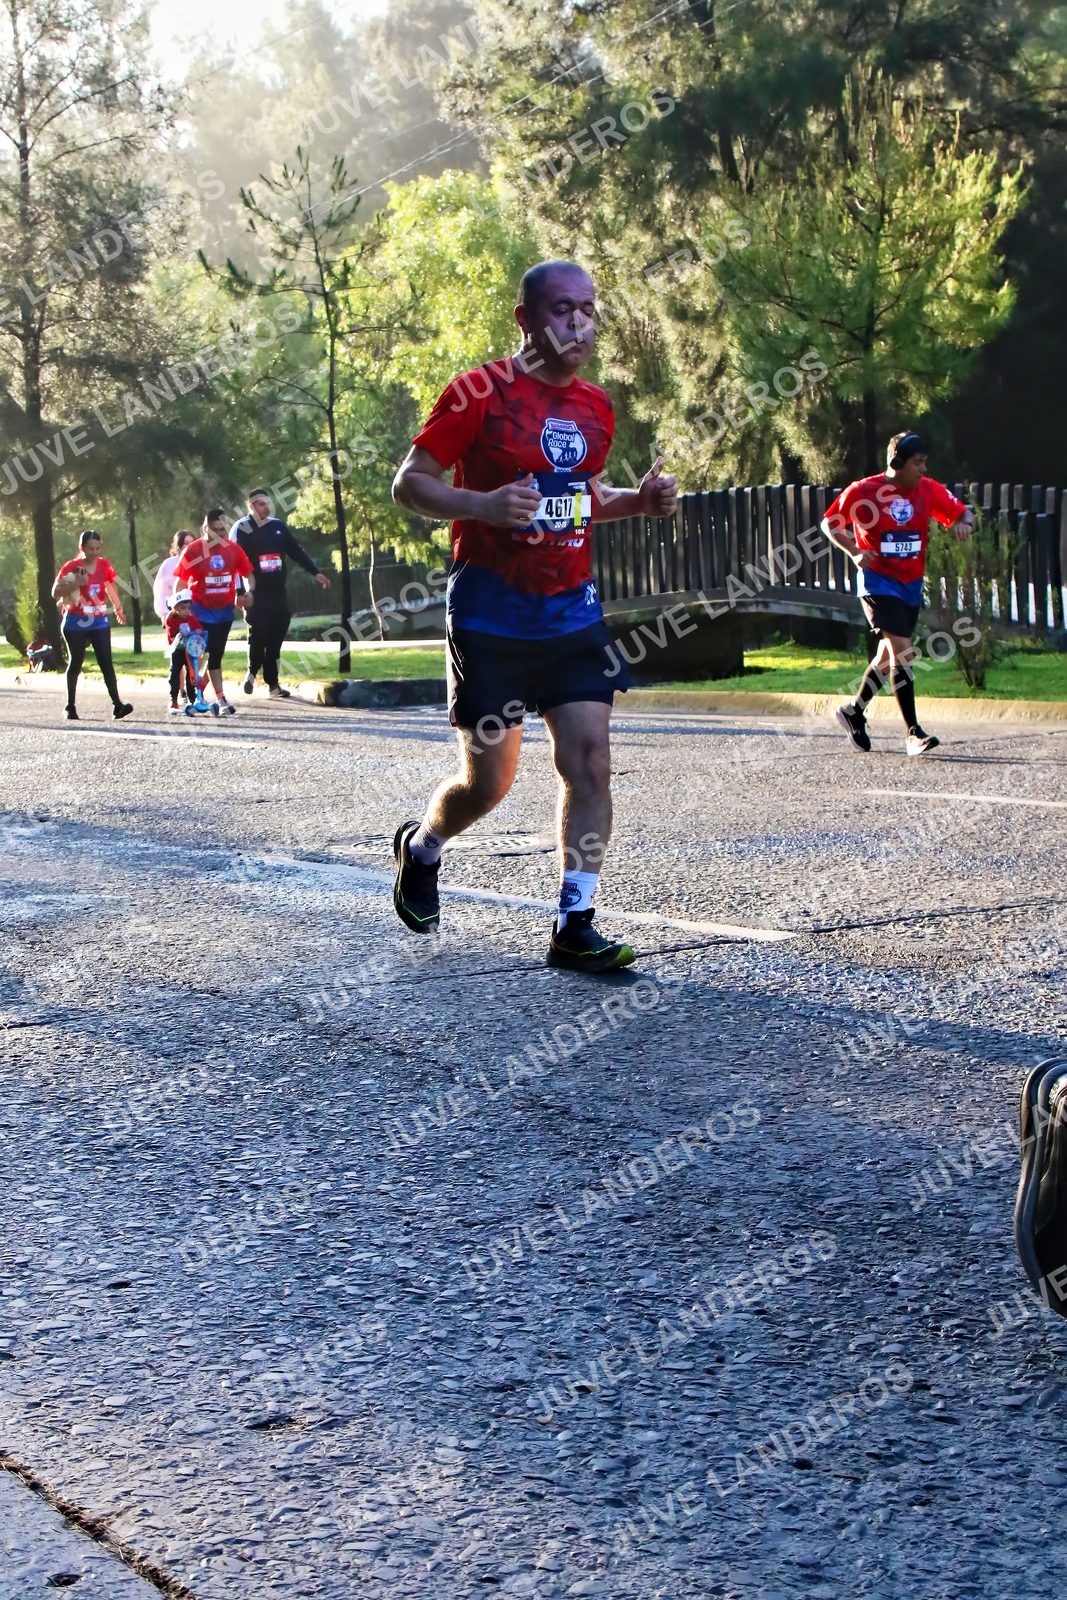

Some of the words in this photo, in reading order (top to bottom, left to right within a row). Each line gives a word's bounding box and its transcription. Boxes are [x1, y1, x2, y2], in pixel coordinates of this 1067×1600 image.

[552, 432, 575, 442] Global
[548, 439, 567, 448] Race
[545, 498, 573, 518] 4617
[895, 542, 912, 552] 5743
